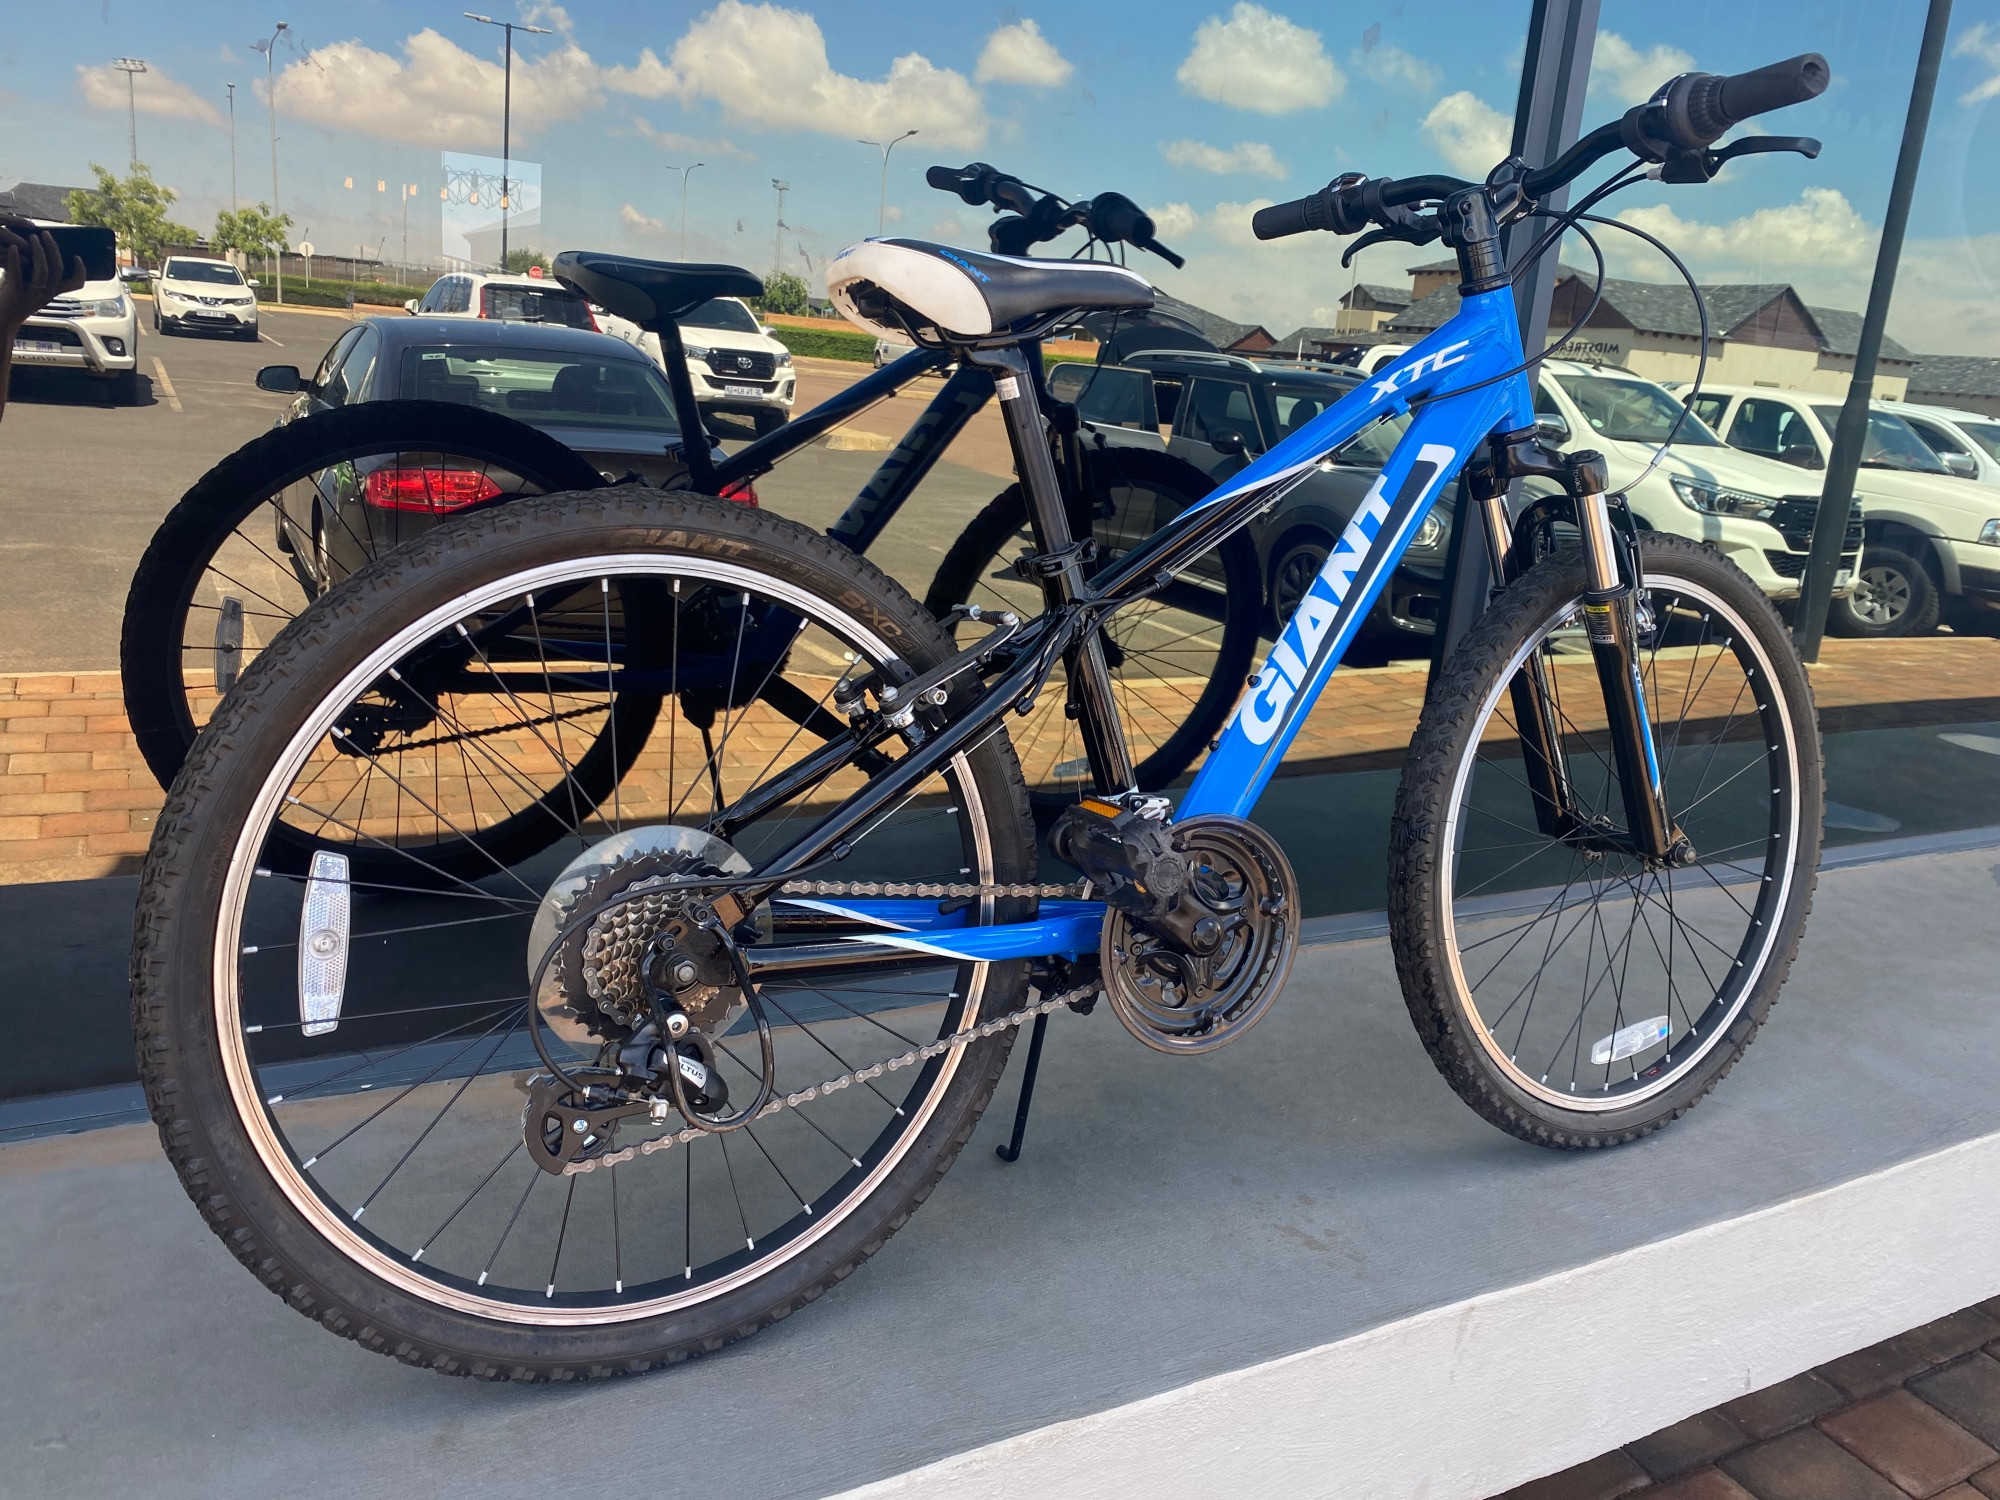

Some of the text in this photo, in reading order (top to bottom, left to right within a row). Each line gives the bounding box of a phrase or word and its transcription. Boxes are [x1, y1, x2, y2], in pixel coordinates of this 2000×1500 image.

[939, 249, 991, 284] GIANT
[1369, 340, 1470, 404] XTC
[609, 528, 751, 557] GIANT
[1240, 473, 1391, 746] GIANT
[680, 1063, 704, 1080] LTUS
